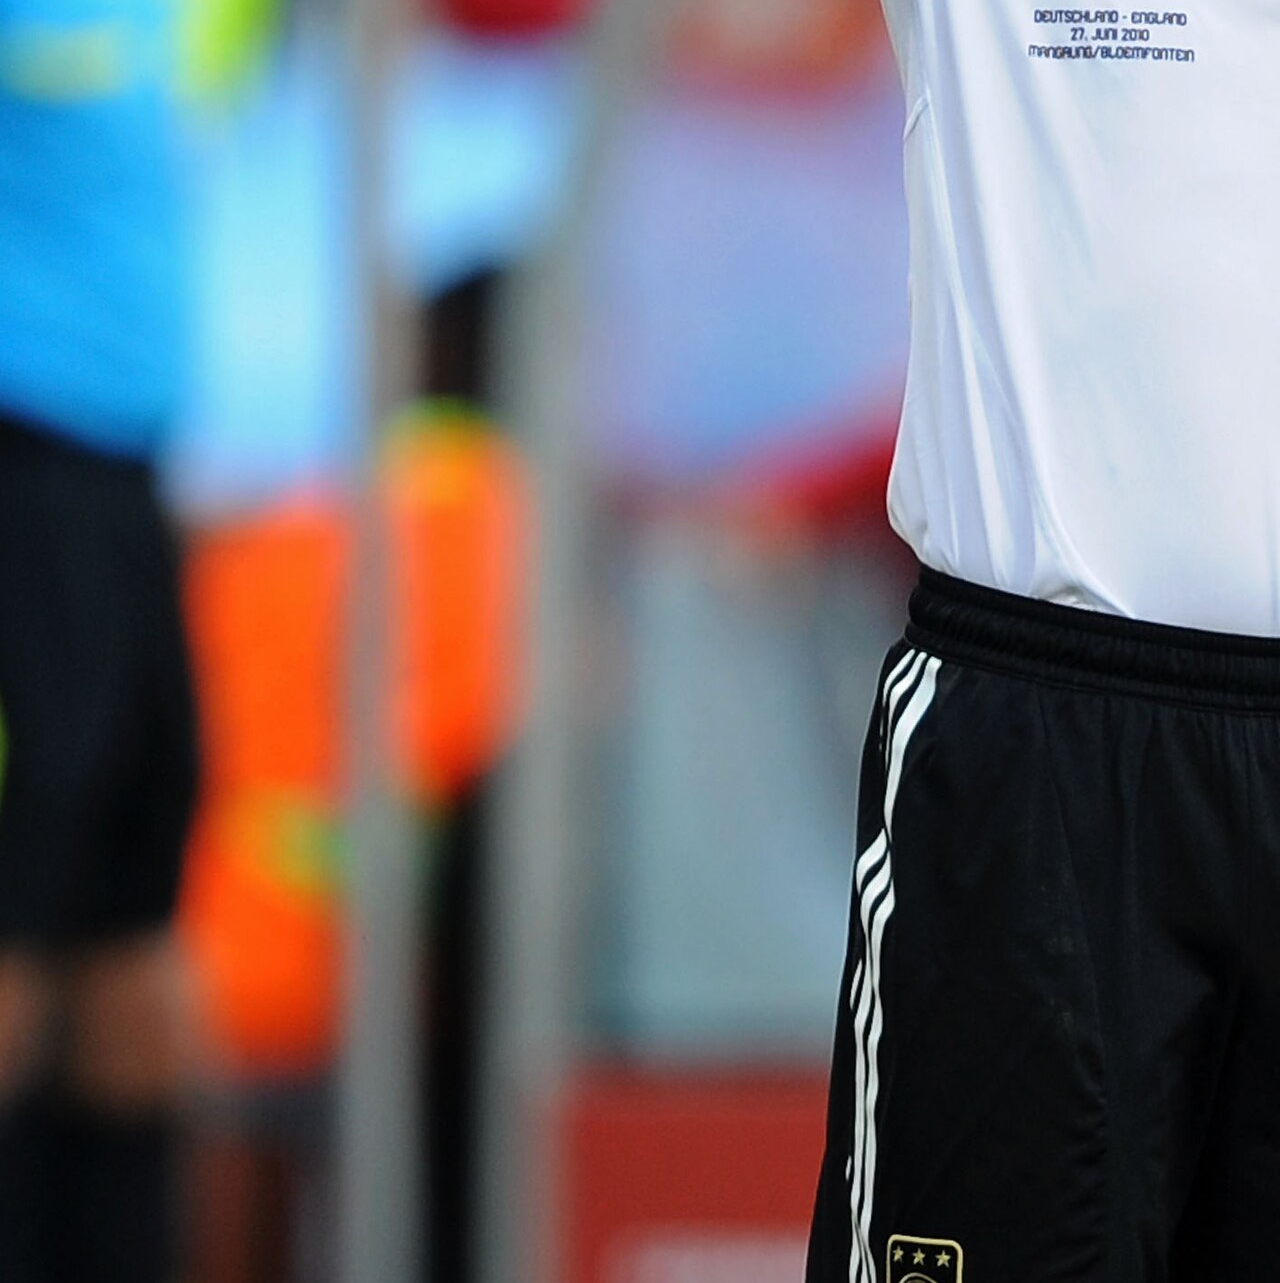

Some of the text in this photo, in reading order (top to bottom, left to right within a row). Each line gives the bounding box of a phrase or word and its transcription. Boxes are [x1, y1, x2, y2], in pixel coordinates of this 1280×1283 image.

[1034, 9, 1119, 24] DEUTSCHLAND
[1130, 11, 1188, 26] ENGLAND
[1070, 27, 1150, 42] 27. JUNI 2010
